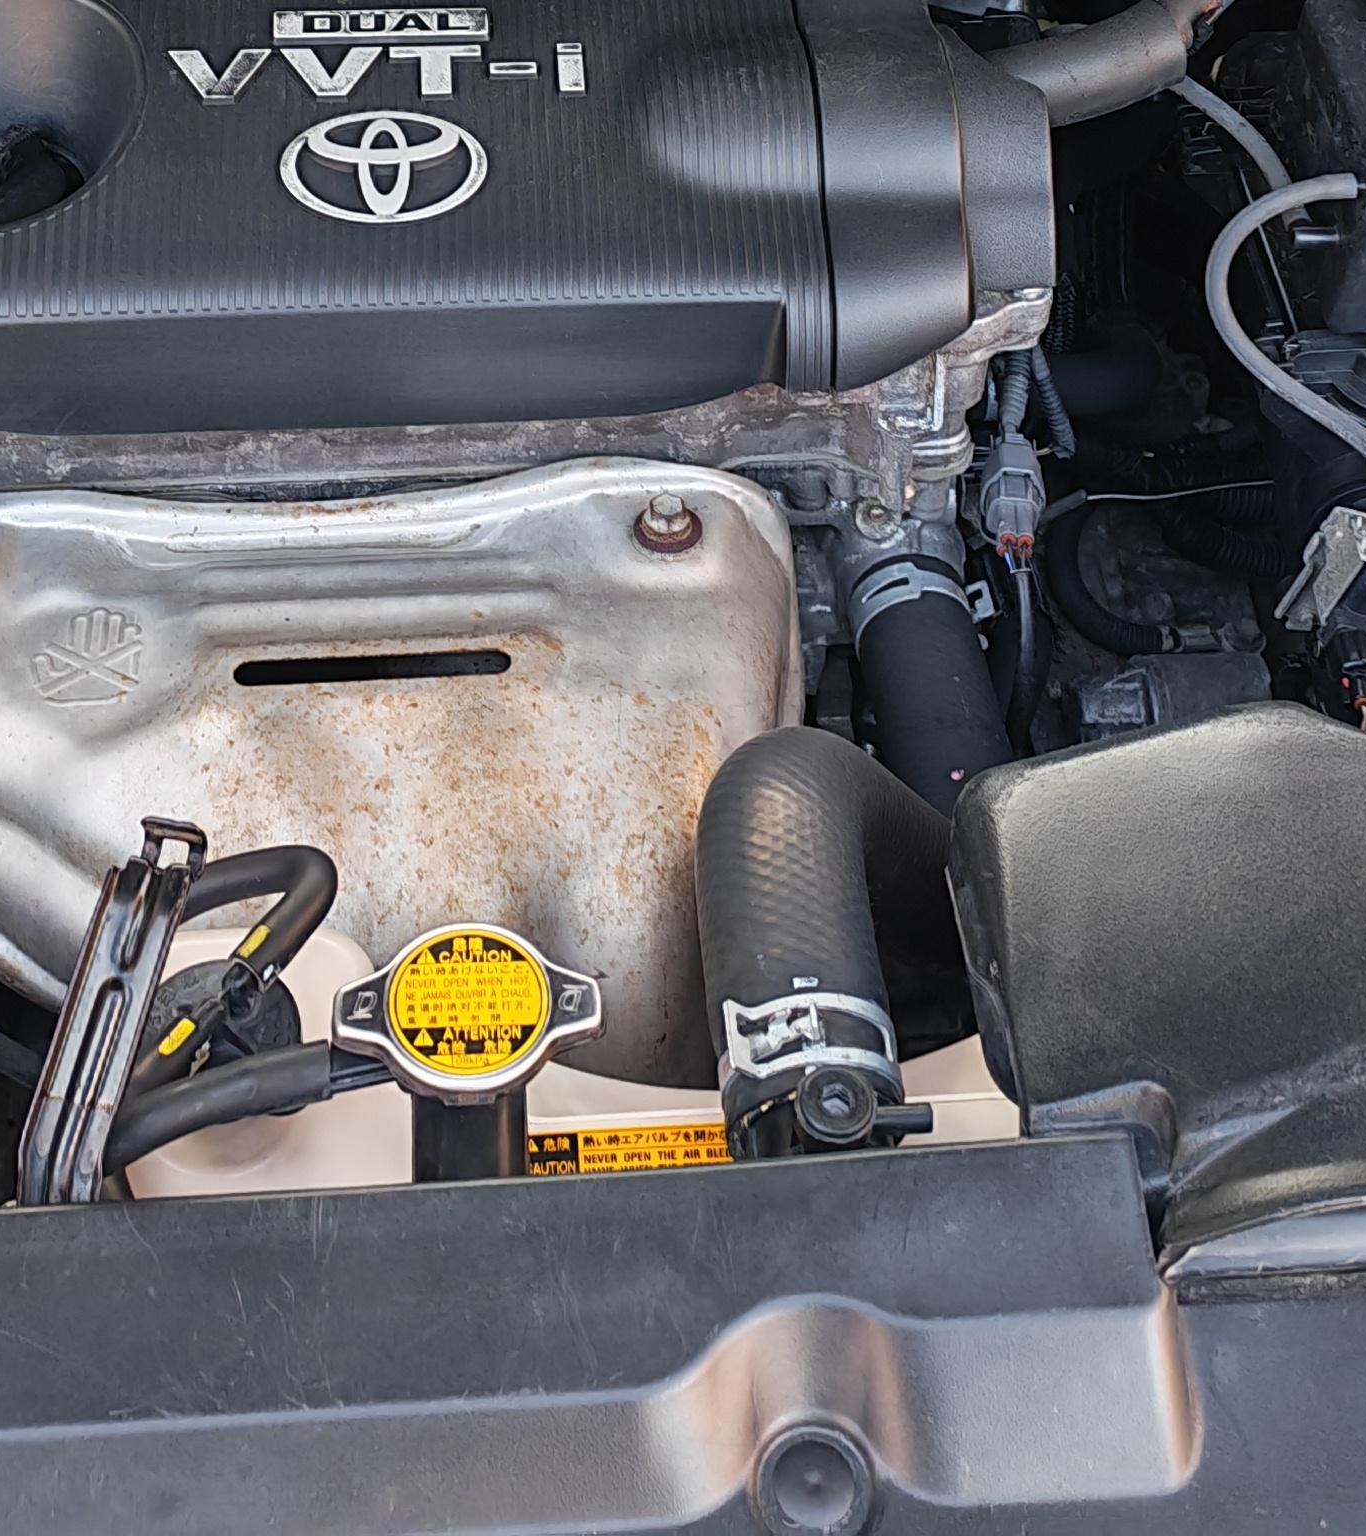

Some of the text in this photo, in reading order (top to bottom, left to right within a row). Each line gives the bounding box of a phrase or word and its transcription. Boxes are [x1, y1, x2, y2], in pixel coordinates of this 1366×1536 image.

[302, 12, 472, 34] DUAL
[167, 42, 587, 102] VVT-i
[438, 949, 512, 963] CAUTION
[405, 978, 436, 989] NEVER
[443, 977, 469, 988] OPEN
[475, 976, 503, 987] WHEN
[405, 991, 416, 1001] NE
[421, 990, 451, 1001] JAMAIS
[455, 989, 487, 1000] OUVRIR
[443, 1024, 522, 1041] ATTENTION
[583, 1153, 618, 1165] NEVER
[623, 1151, 651, 1163] OPEN
[658, 1149, 677, 1161] THE
[683, 1148, 701, 1160] AIR
